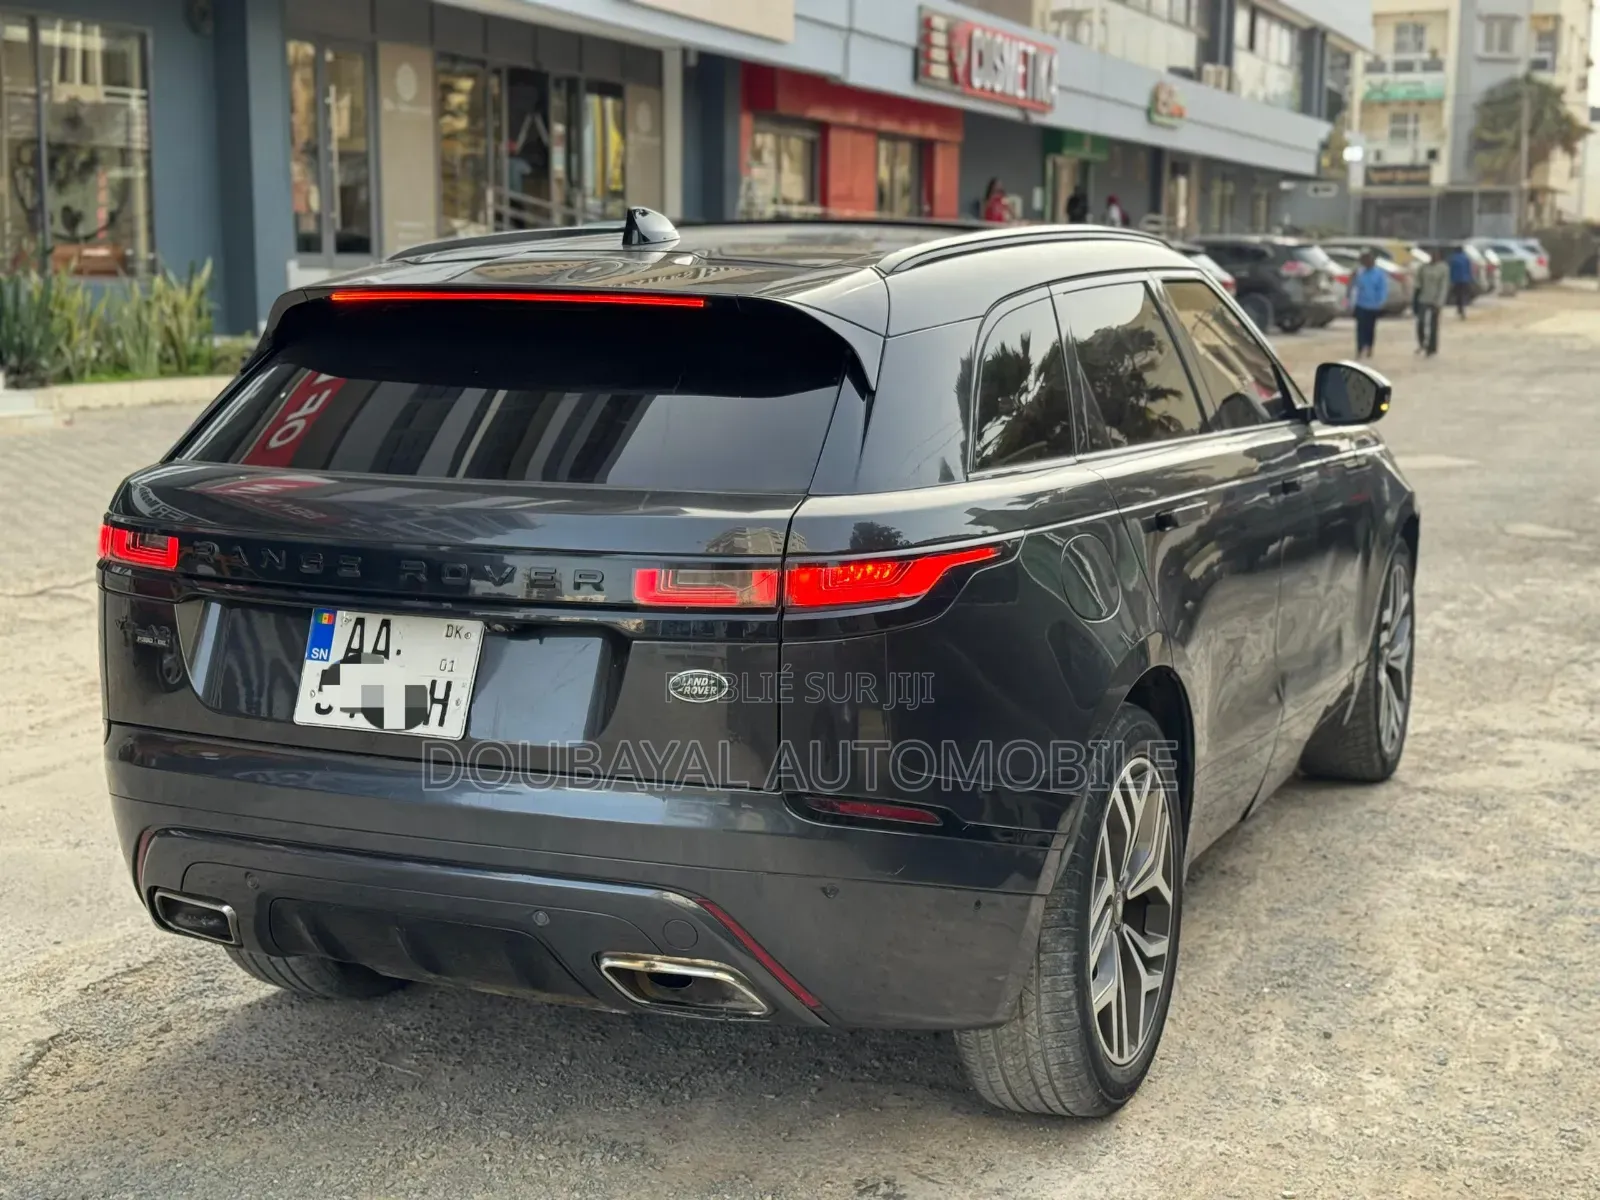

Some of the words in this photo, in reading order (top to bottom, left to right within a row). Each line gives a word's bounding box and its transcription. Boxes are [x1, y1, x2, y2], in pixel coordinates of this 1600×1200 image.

[190, 540, 363, 578] RANGE
[399, 559, 606, 592] ROVER
[445, 623, 463, 639] DK
[310, 647, 329, 660] SN
[438, 658, 455, 673] 01
[681, 677, 709, 686] LAND
[683, 686, 717, 695] ROVER
